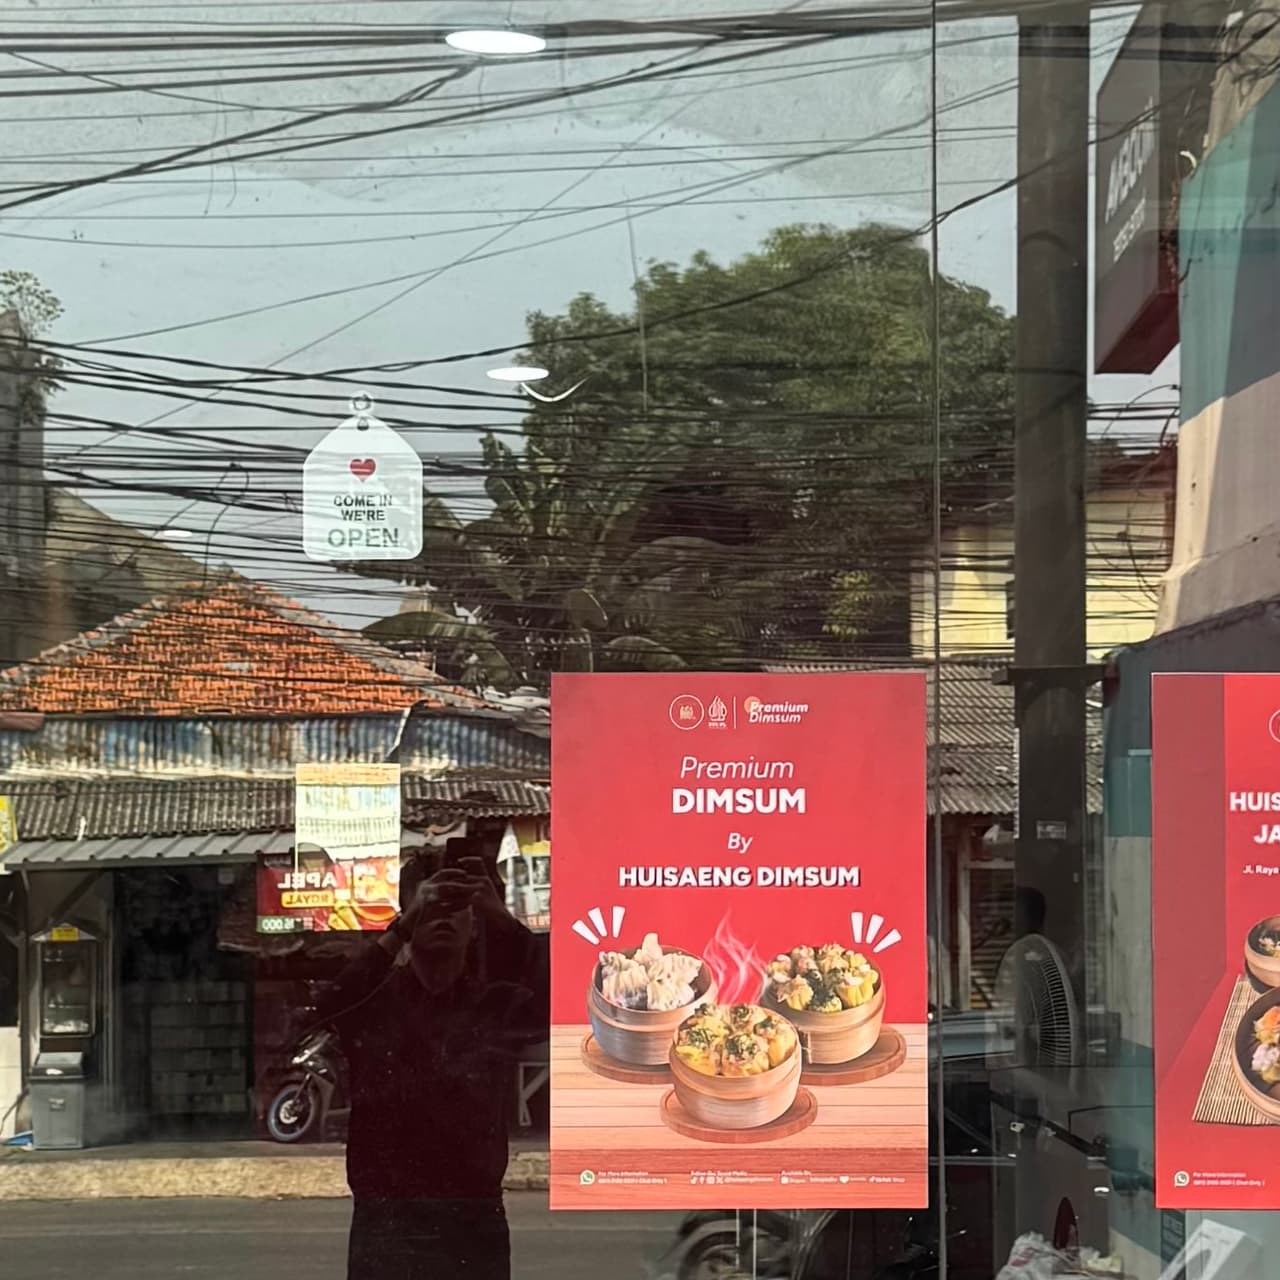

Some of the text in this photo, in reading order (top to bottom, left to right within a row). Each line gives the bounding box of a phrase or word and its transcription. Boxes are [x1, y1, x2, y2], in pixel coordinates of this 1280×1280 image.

[334, 495, 392, 507] COME IN
[341, 510, 385, 521] WE'RE
[328, 528, 399, 547] OPEN
[750, 700, 809, 713] Premium
[749, 711, 801, 724] Dimsum
[680, 755, 794, 779] Premium
[672, 788, 806, 813] DIMSUM
[727, 832, 753, 853] By
[619, 866, 860, 887] HUISAENG DIMSUM
[1256, 865, 1279, 876] Raya
